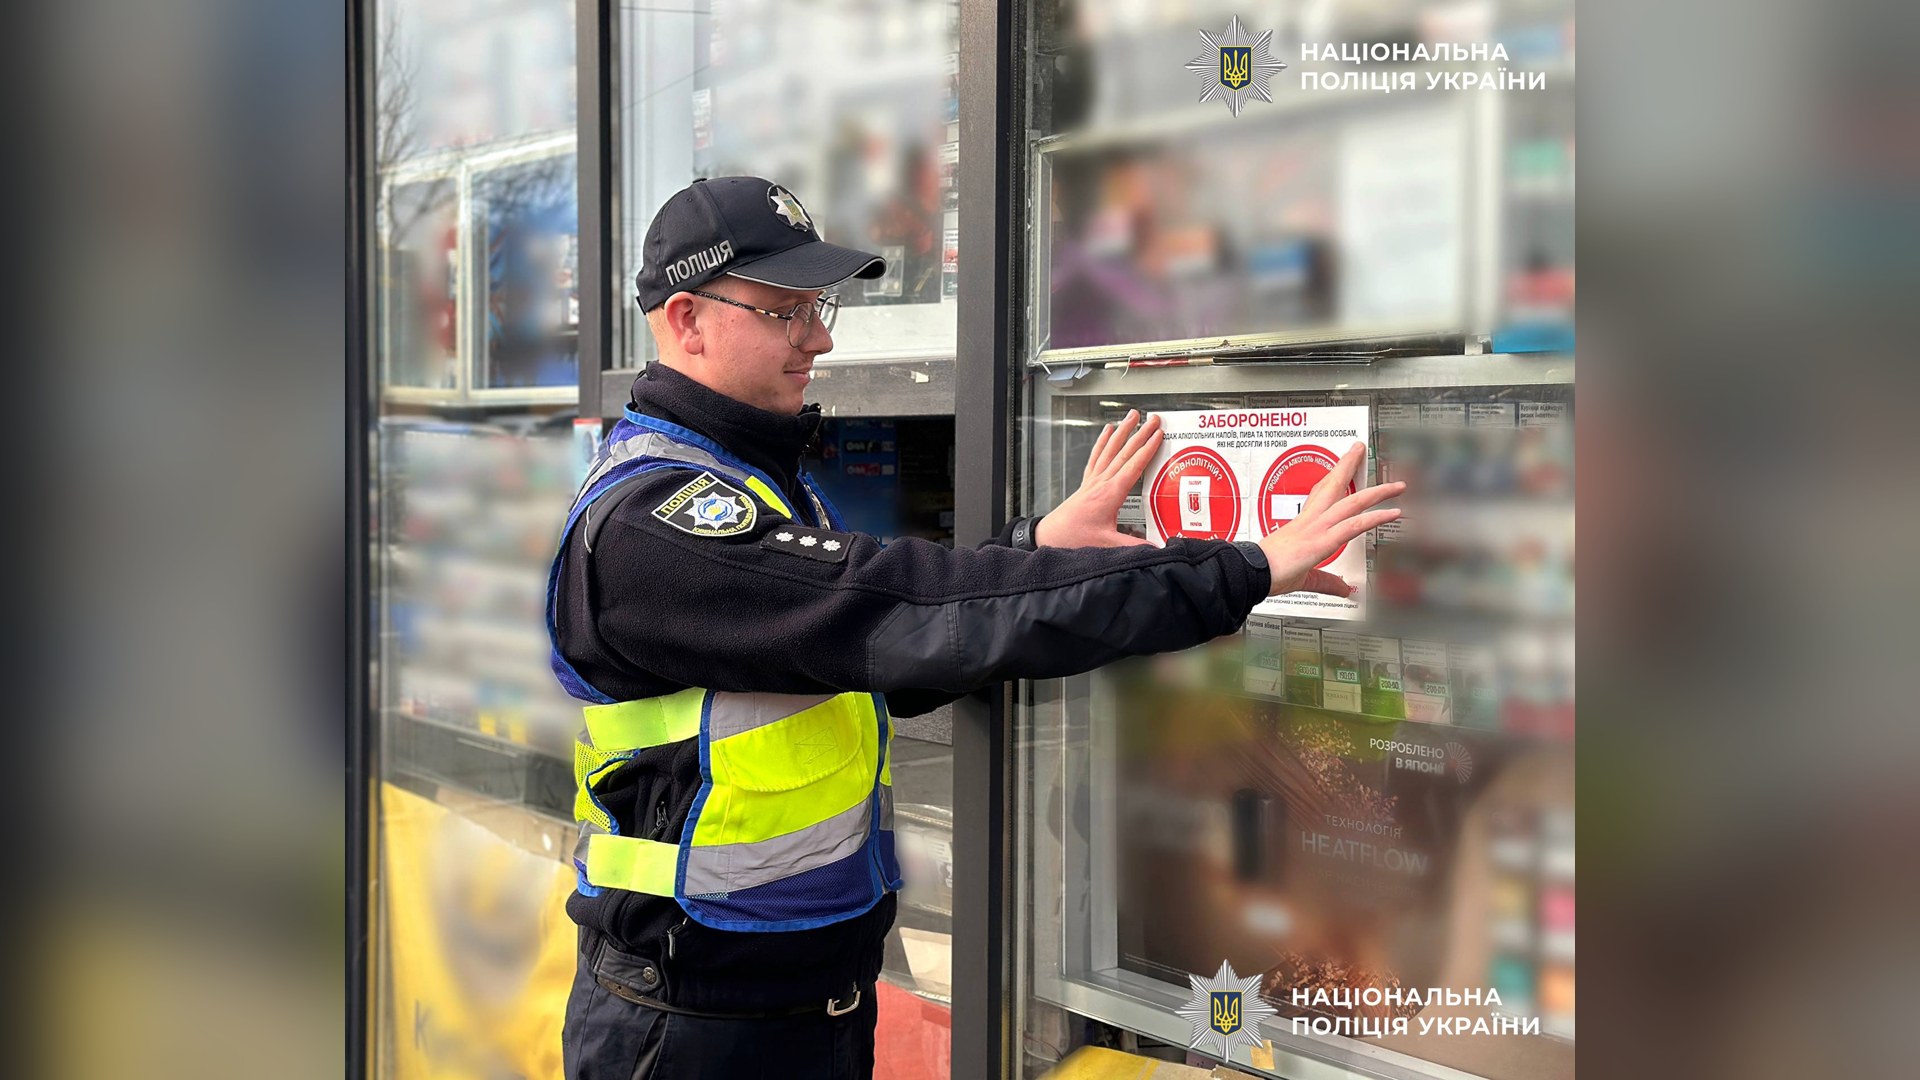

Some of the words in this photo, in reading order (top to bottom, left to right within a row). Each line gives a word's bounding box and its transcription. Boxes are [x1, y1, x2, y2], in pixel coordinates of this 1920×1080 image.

[665, 239, 735, 286] ПОЛІЦІЯ
[1198, 412, 1308, 429] ЗАБОРОНЕНО!
[1163, 432, 1177, 440] ОДАЖ
[1178, 432, 1215, 440] АЛКОГОЛЬНИХ
[1215, 429, 1239, 440] НАПОЇВ,
[1240, 431, 1255, 439] ПИВА
[1256, 430, 1264, 438] ТА
[1265, 430, 1302, 438] ТЮТЮНОВИХ
[1303, 429, 1329, 438] ВИРОБІВ
[1330, 429, 1358, 438] ОСОБАМ,
[1226, 440, 1235, 448] НЕ
[1236, 440, 1263, 449] ДОСЯГЛИ
[1263, 440, 1270, 448] 18
[1271, 440, 1288, 448] РОКІВ
[1168, 457, 1223, 481] ПОВНОЛІТНІЙ?
[660, 478, 711, 515] ПОЛІЦІЯ
[1188, 493, 1200, 512] 18
[1369, 738, 1444, 759] РОЗРОБЛЕНО
[1396, 757, 1403, 769] В
[1404, 759, 1445, 775] ЯПОНІЇ
[1324, 814, 1402, 839] ТЕХНОЛОГІЯ
[1301, 831, 1429, 877] HEATFLOW
